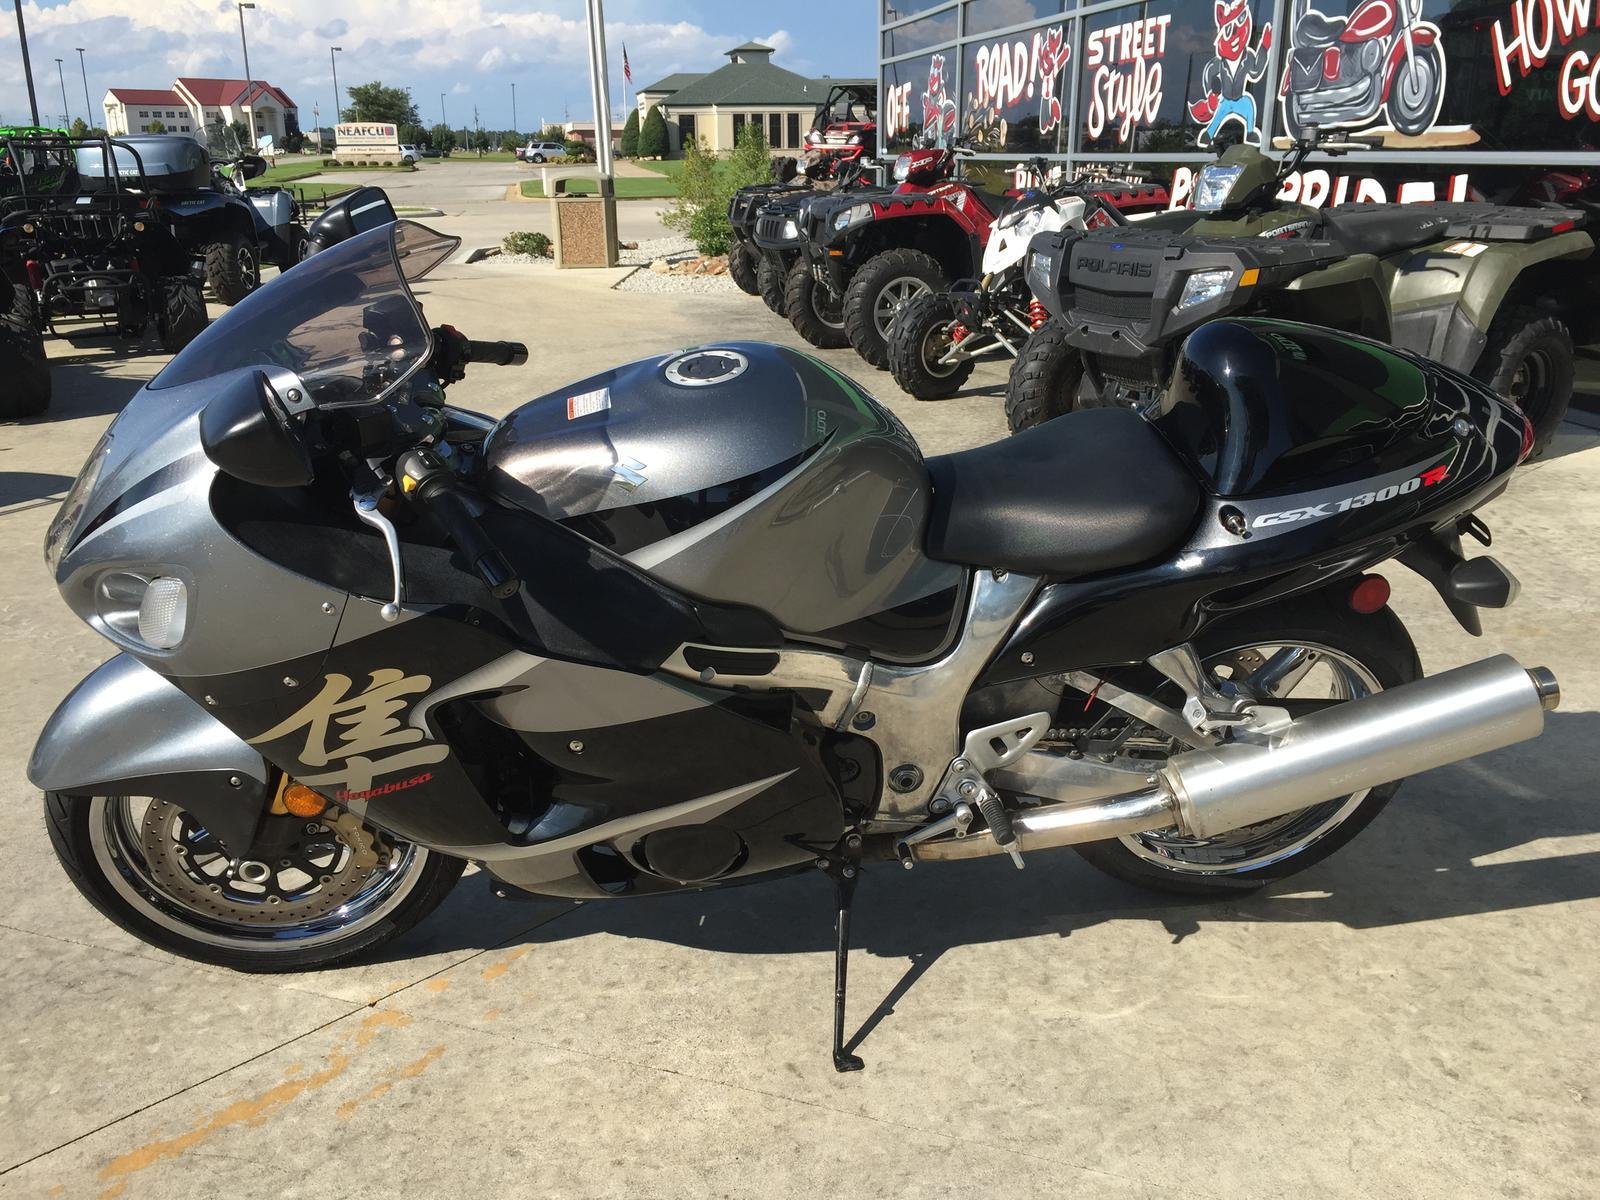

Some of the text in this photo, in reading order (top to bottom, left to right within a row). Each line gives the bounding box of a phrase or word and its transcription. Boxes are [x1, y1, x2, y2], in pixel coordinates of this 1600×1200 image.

[1087, 14, 1172, 66] STREET
[886, 81, 912, 138] OFF
[1088, 56, 1163, 143] Style
[338, 126, 384, 136] NEAFCU
[1076, 256, 1152, 277] POLARIS
